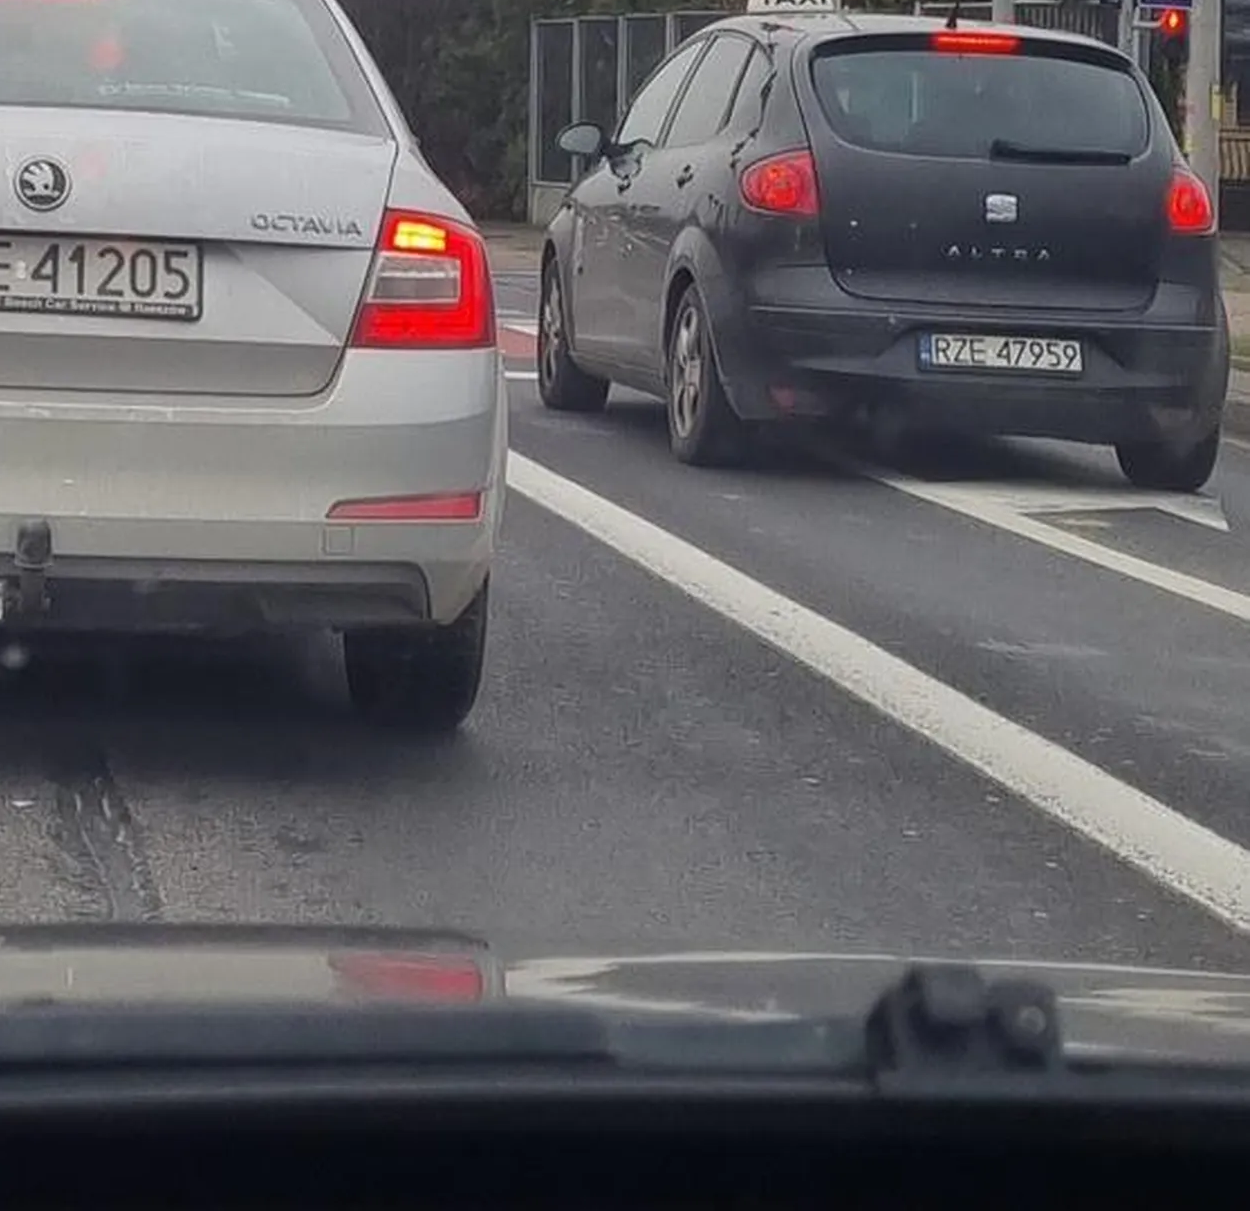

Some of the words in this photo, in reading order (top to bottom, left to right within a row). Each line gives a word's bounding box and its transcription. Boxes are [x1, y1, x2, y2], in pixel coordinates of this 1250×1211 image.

[251, 214, 362, 236] OCTAVIA
[31, 243, 191, 299] 41205
[935, 338, 986, 364] RZE
[996, 340, 1078, 368] 47959
